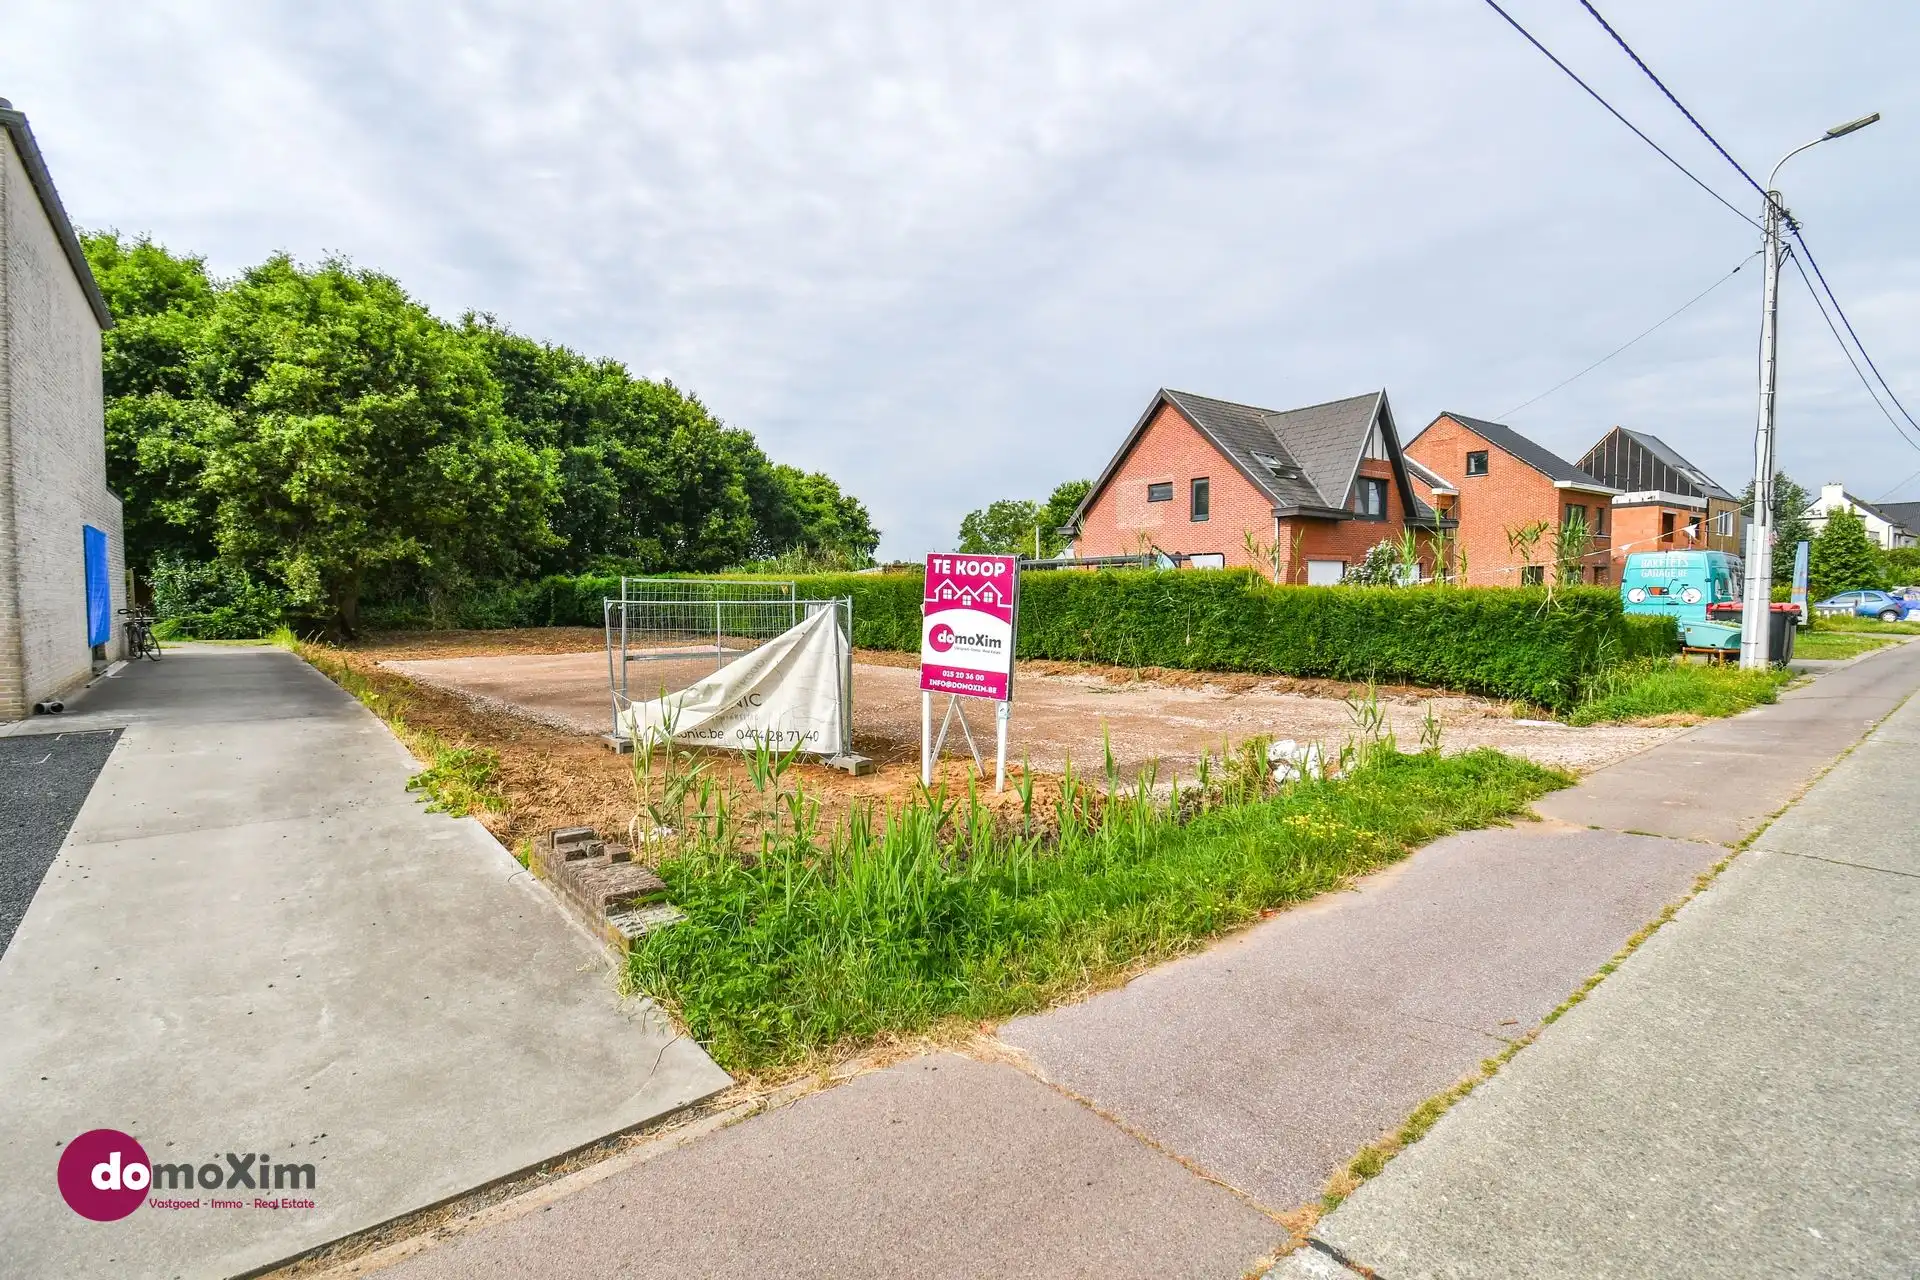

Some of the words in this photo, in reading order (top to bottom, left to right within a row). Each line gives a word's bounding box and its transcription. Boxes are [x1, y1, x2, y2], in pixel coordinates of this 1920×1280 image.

[933, 559, 951, 574] TE
[955, 560, 1006, 577] KOOP
[937, 629, 1002, 649] domoXim
[955, 671, 964, 679] 20
[805, 730, 820, 742] 40
